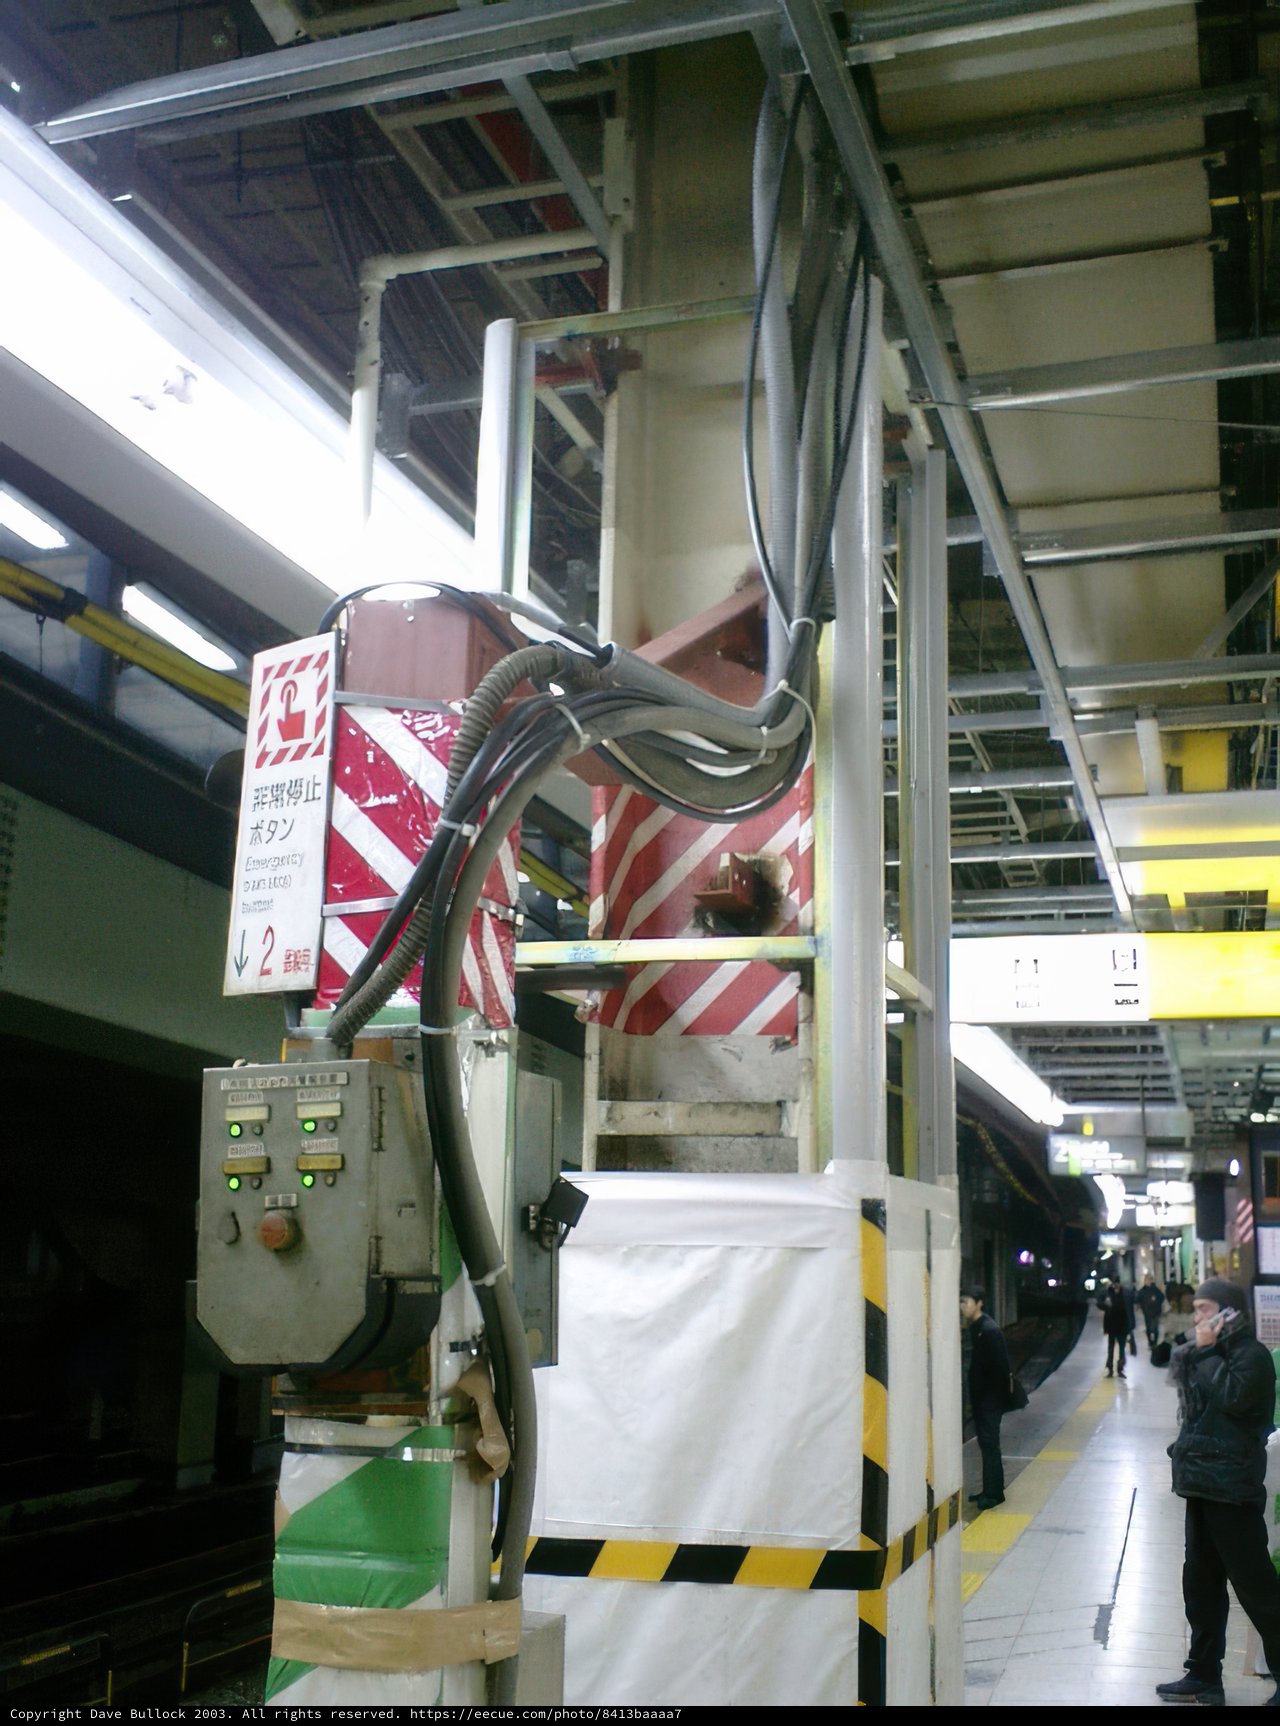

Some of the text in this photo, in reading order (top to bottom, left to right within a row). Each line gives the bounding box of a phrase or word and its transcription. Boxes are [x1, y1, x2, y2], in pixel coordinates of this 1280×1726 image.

[249, 818, 295, 846] ボタン
[259, 925, 275, 977] 2
